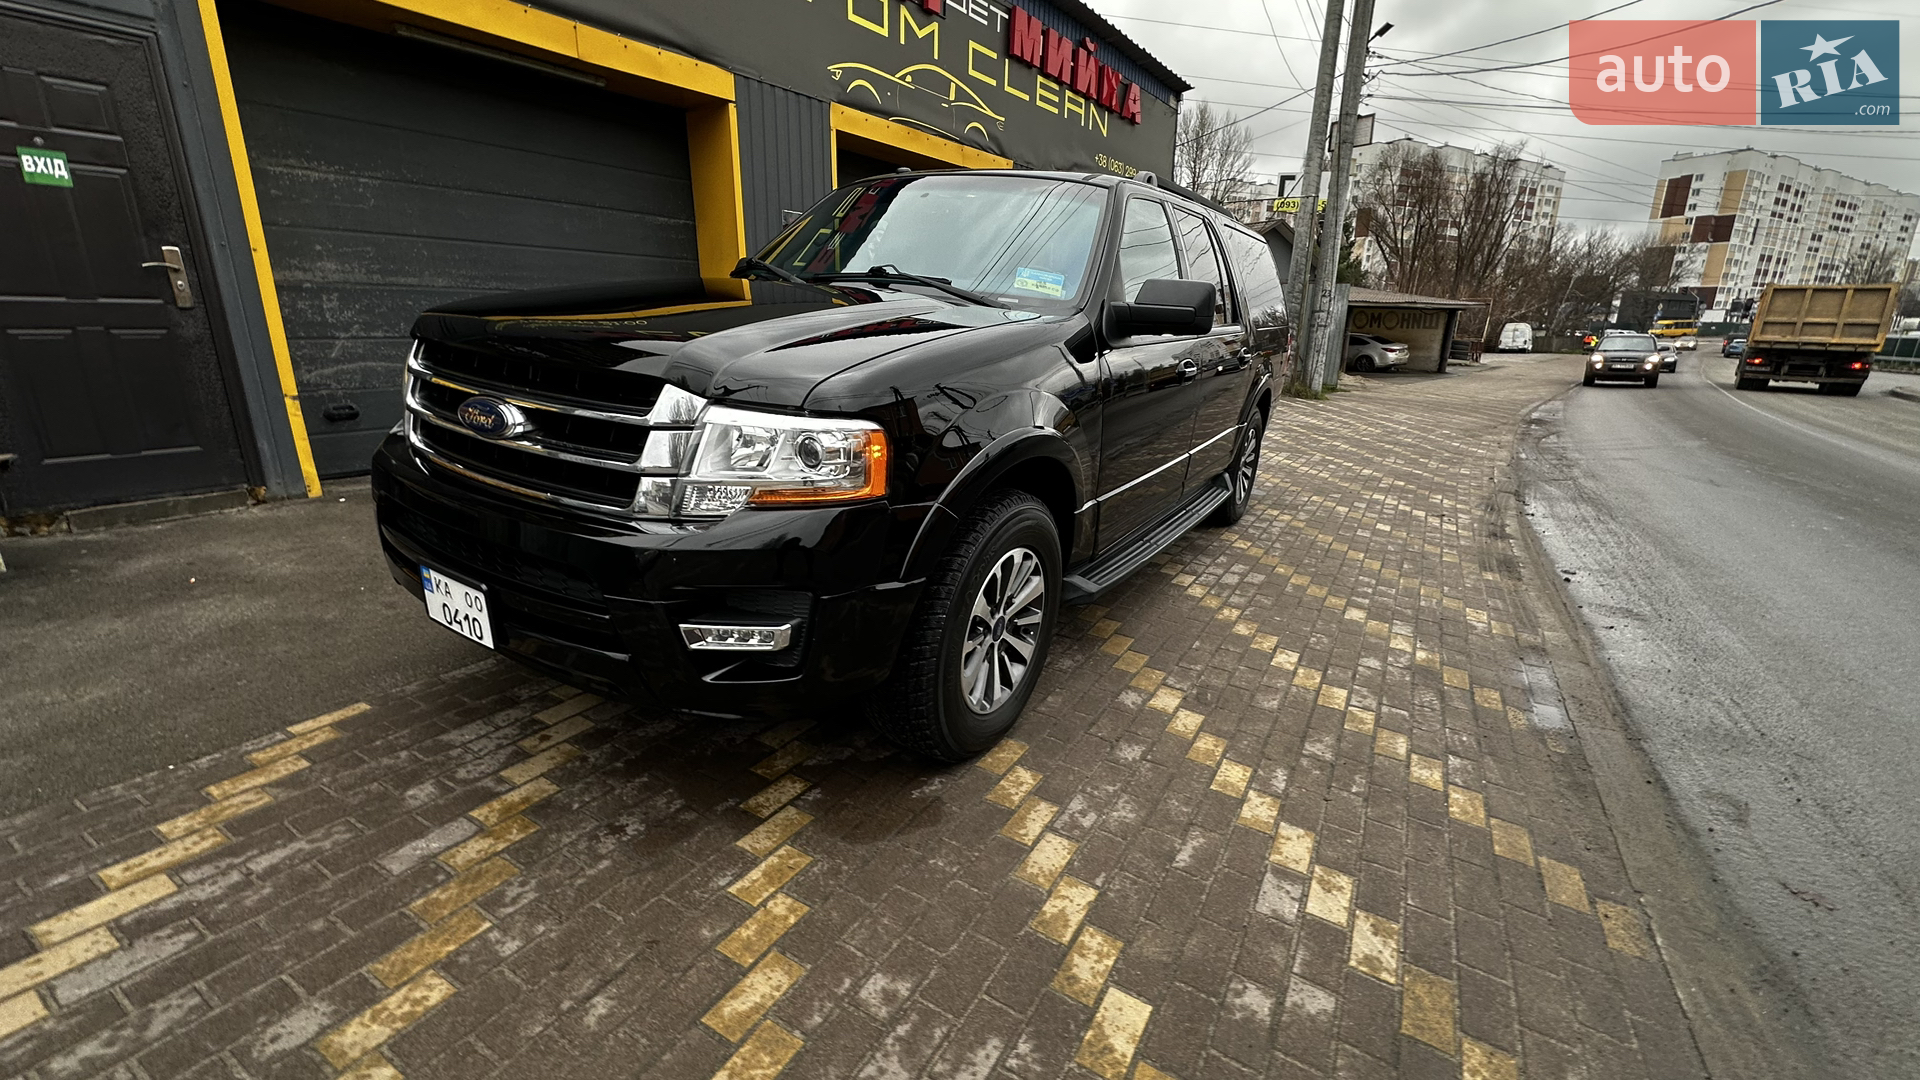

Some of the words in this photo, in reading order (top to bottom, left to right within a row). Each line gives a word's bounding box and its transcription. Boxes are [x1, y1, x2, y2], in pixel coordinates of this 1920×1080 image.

[968, 39, 1108, 138] CLEAN
[21, 154, 69, 180] ВХІД
[1094, 153, 1107, 168] +38
[1108, 156, 1125, 176] (063)
[1276, 200, 1299, 210] (093)
[464, 406, 496, 430] Ford
[433, 576, 453, 600] KA
[464, 591, 483, 613] 00
[442, 602, 483, 641] 0410
